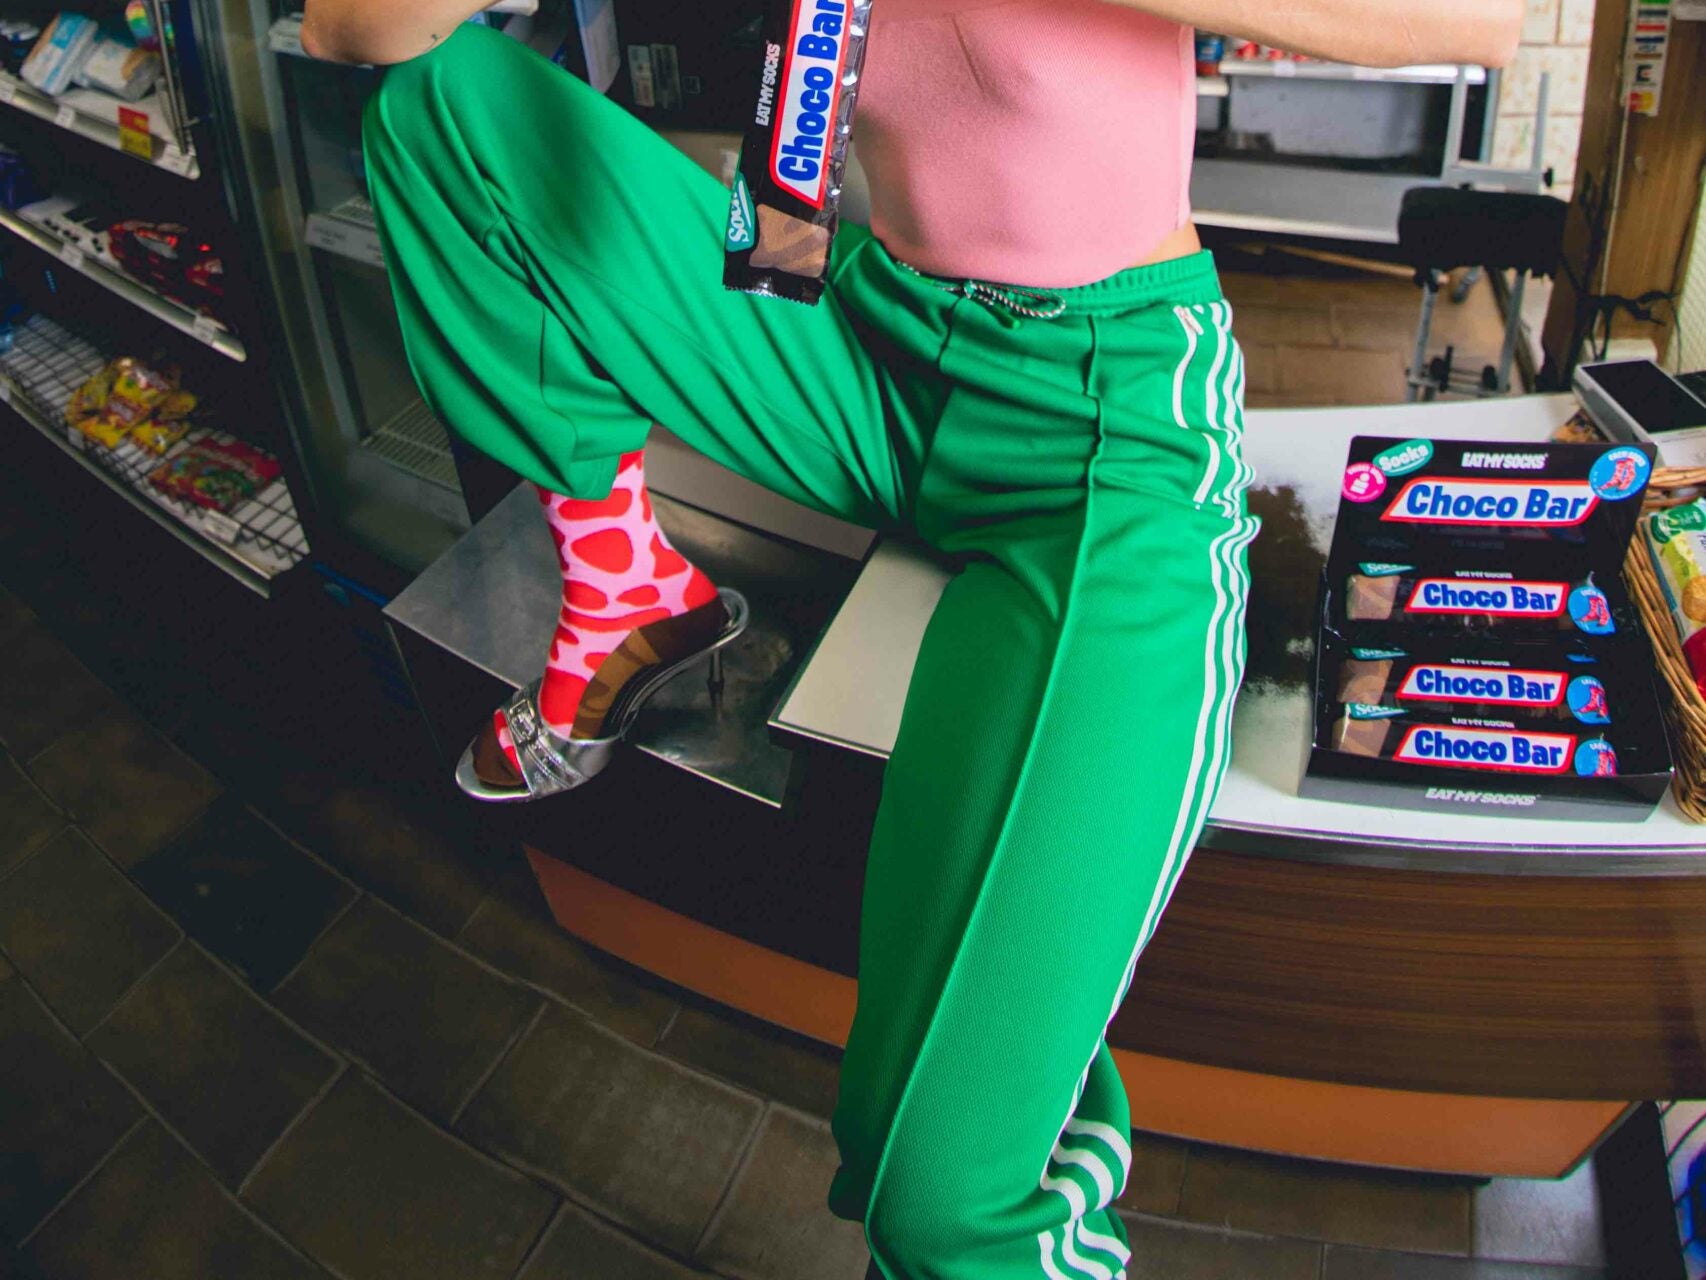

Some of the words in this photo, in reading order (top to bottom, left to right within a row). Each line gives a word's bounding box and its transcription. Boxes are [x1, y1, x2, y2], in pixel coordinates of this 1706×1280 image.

[778, 66, 834, 182] Choco
[1378, 445, 1430, 472] Socks
[1406, 483, 1519, 519] Choco
[1523, 488, 1588, 520] Bar
[1423, 583, 1508, 608] Choco
[1511, 586, 1557, 611] Bar
[1416, 668, 1503, 697] Choco
[1507, 674, 1556, 701] Bar
[1414, 729, 1507, 762] Choco
[1512, 736, 1562, 766] Bar
